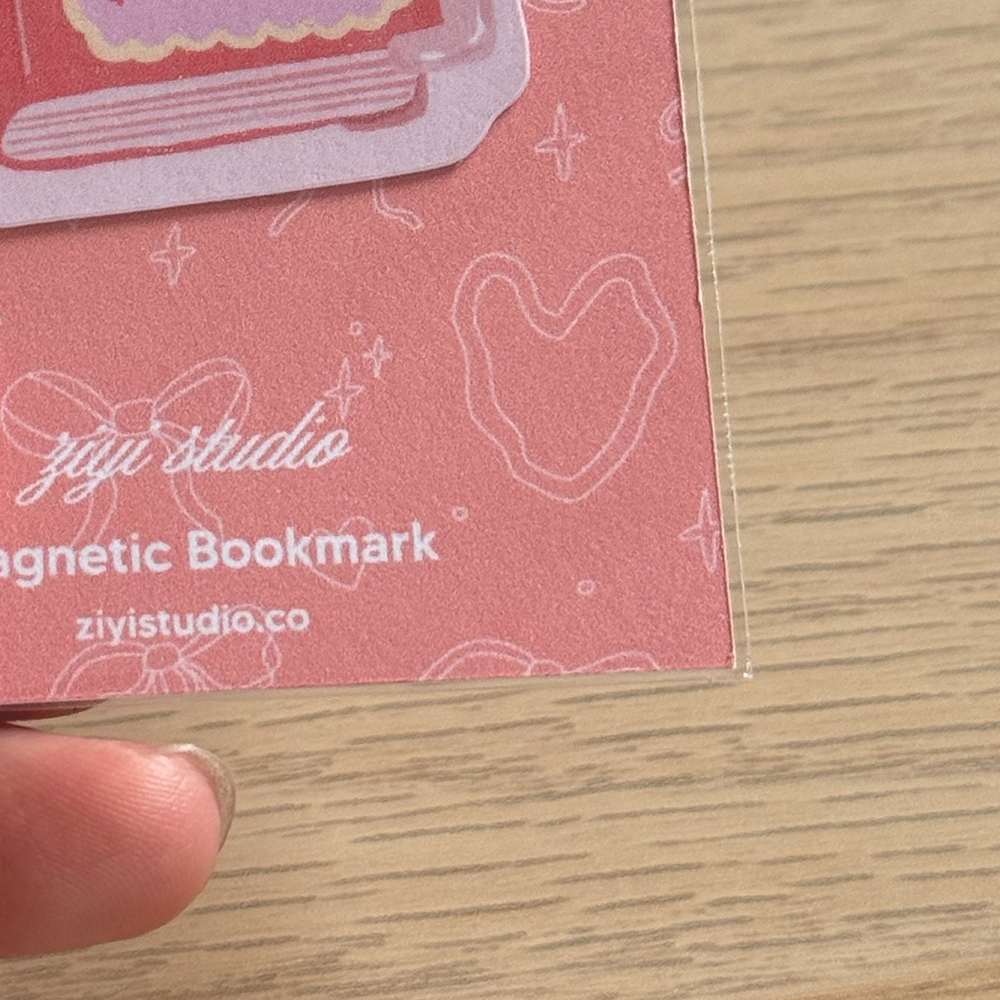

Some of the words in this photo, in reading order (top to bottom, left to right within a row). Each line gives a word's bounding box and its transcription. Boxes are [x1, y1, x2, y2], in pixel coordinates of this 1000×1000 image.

[162, 400, 353, 474] studio
[187, 520, 439, 571] Bookmark
[75, 604, 311, 645] ziyistudio.co
